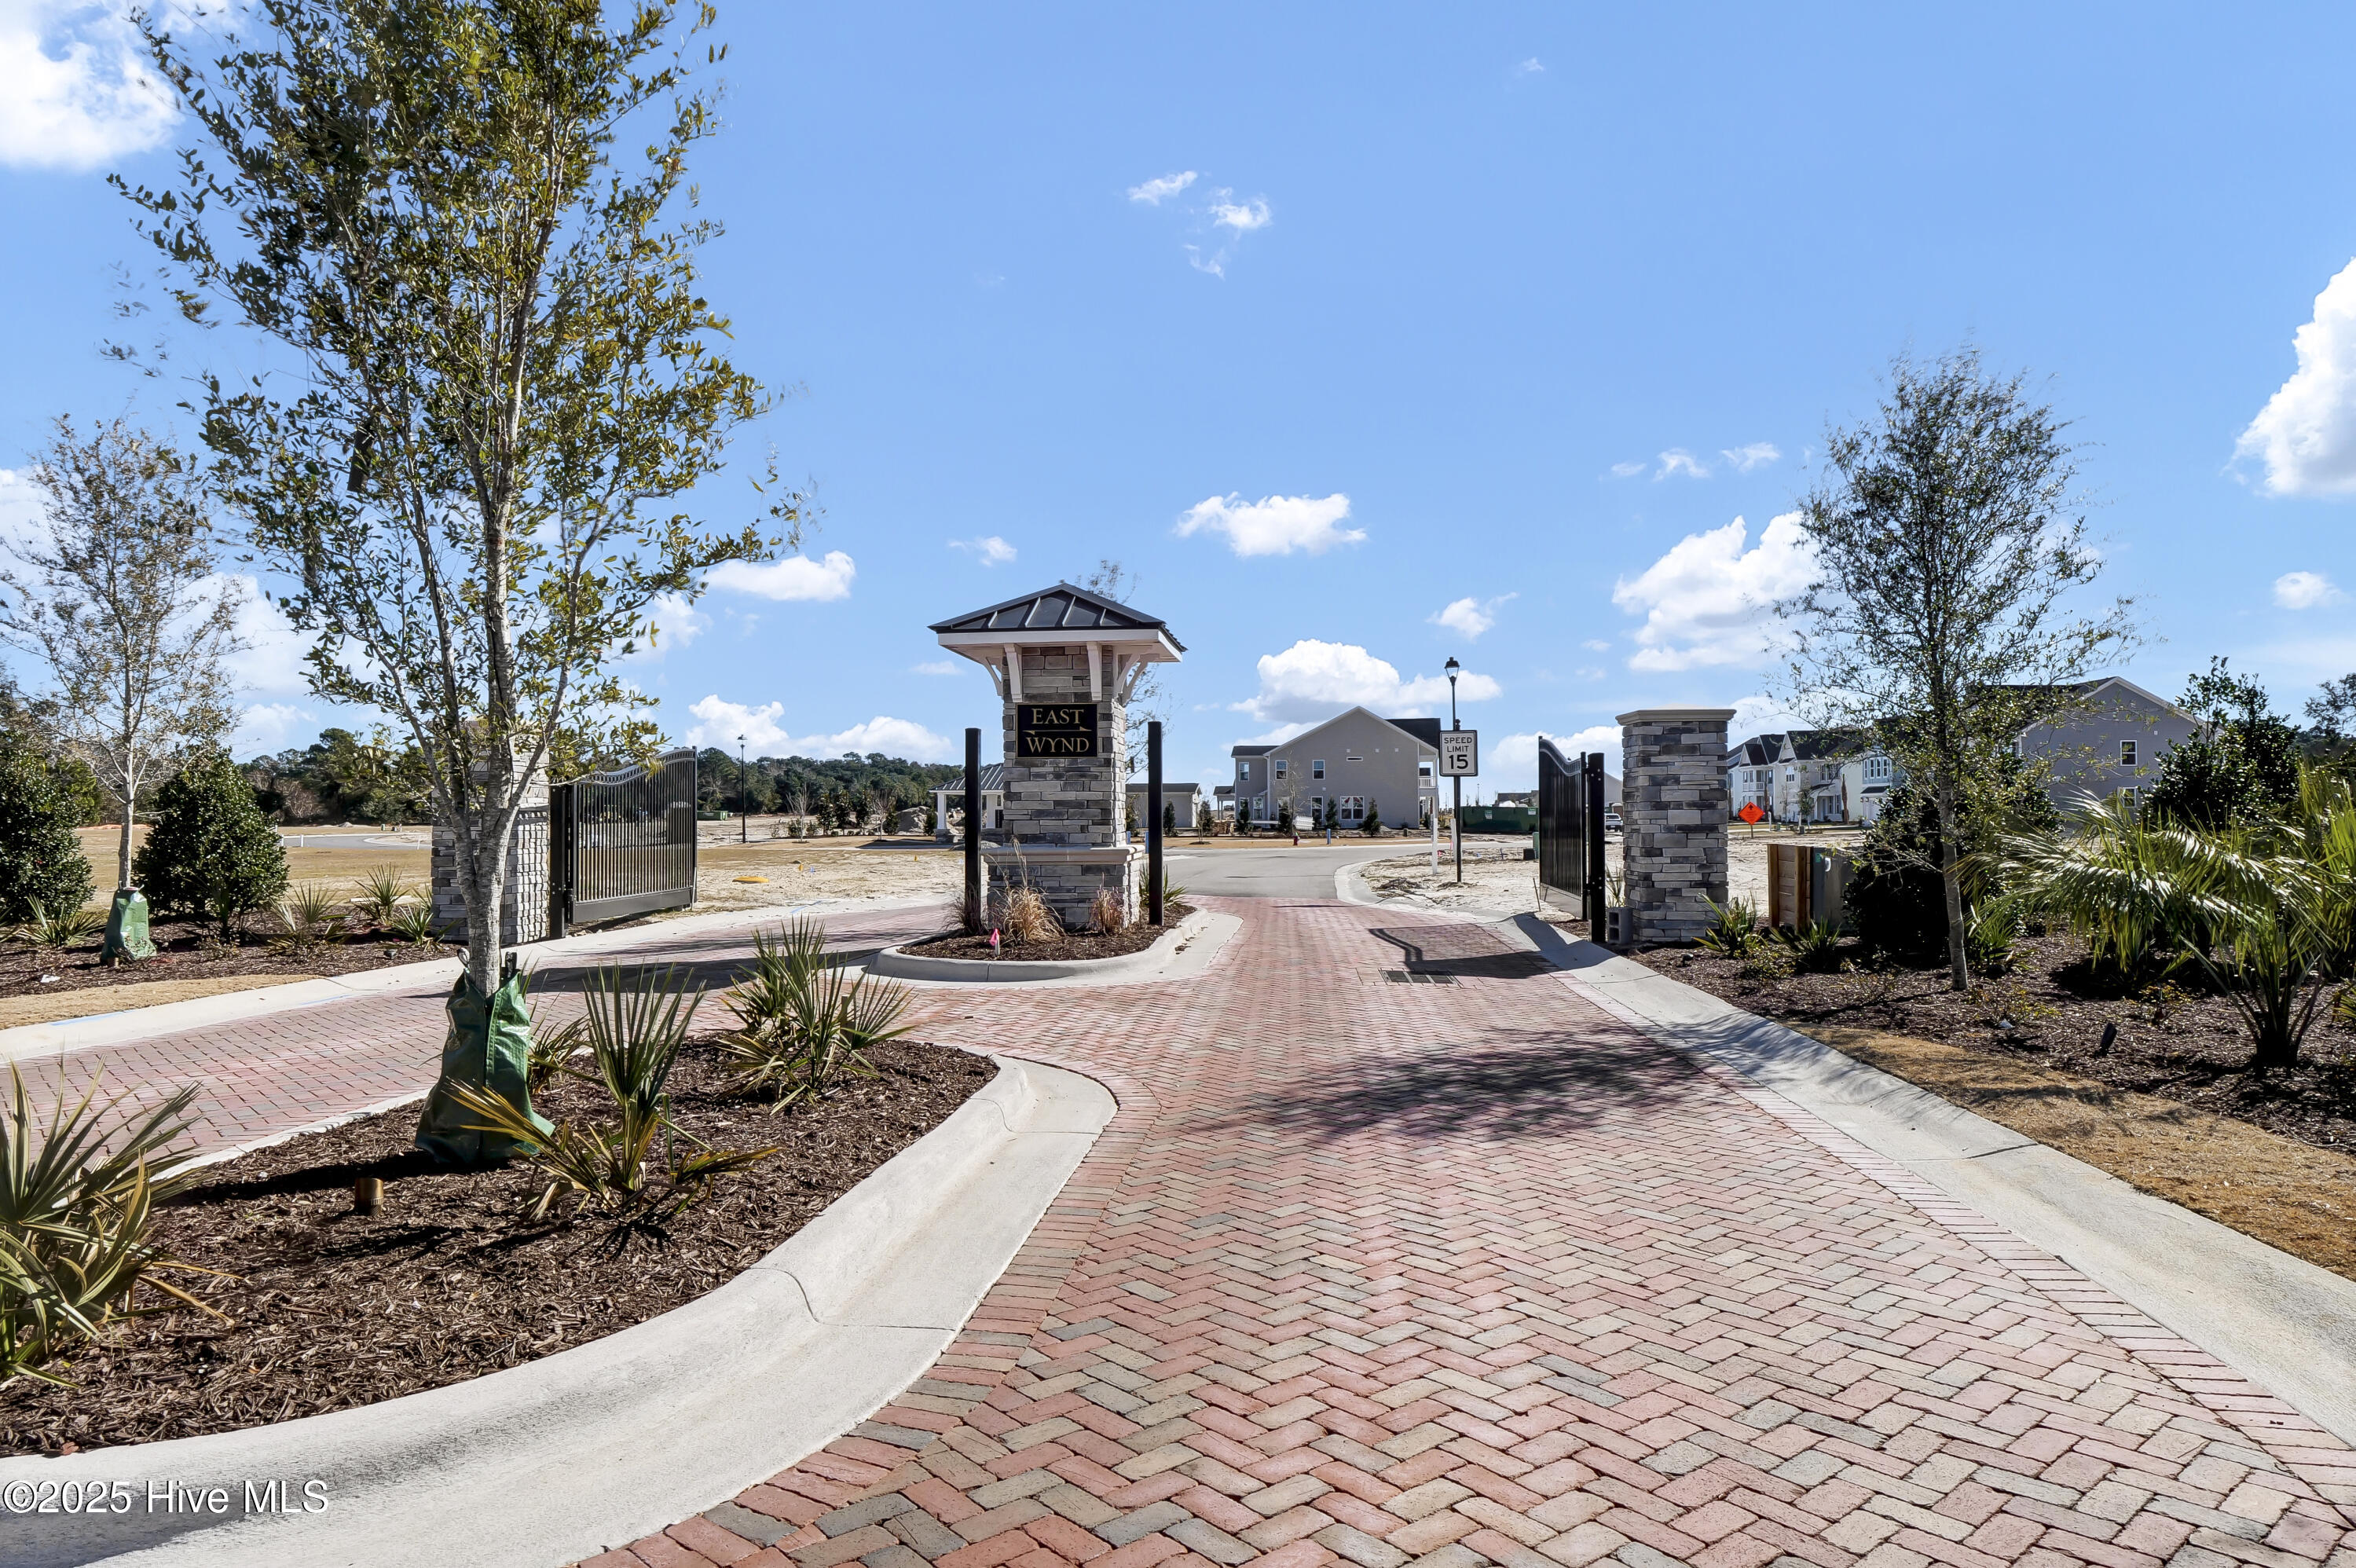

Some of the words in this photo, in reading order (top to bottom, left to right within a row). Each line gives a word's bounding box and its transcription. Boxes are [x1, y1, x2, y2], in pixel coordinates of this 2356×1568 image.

[1031, 708, 1084, 724] EAST
[1025, 737, 1090, 753] WYND
[1449, 754, 1468, 770] 15
